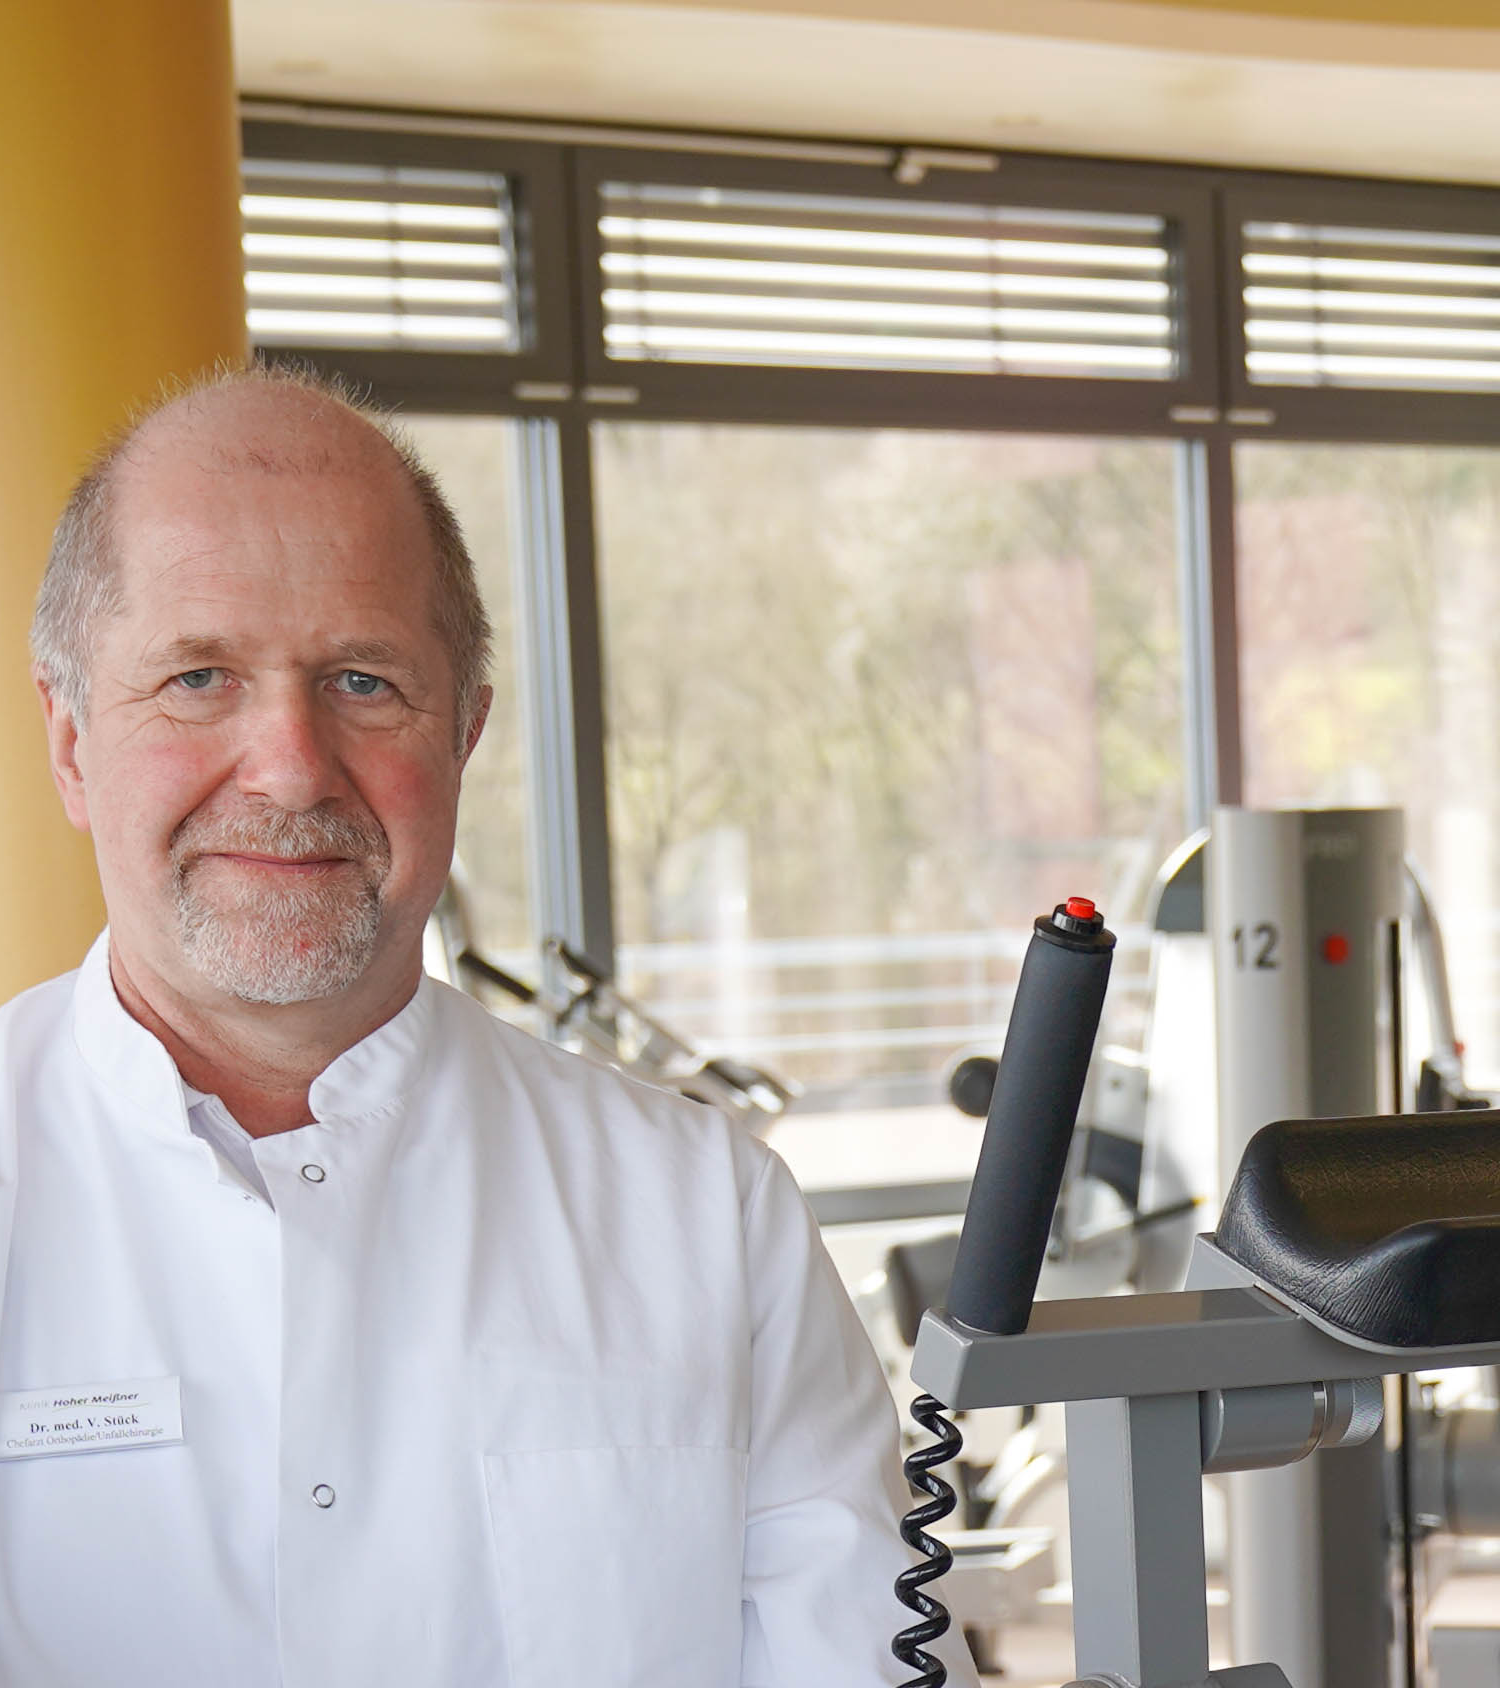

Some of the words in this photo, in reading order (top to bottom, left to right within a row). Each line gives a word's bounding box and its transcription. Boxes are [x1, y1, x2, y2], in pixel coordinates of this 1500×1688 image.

[1233, 922, 1280, 969] 12
[53, 1397, 89, 1408] Hoher
[91, 1392, 140, 1404] Meißner
[30, 1422, 50, 1434] Dr.
[54, 1419, 84, 1432] med.
[87, 1418, 101, 1428] V.
[104, 1413, 140, 1426] Stück
[6, 1437, 45, 1449] Chefarzt
